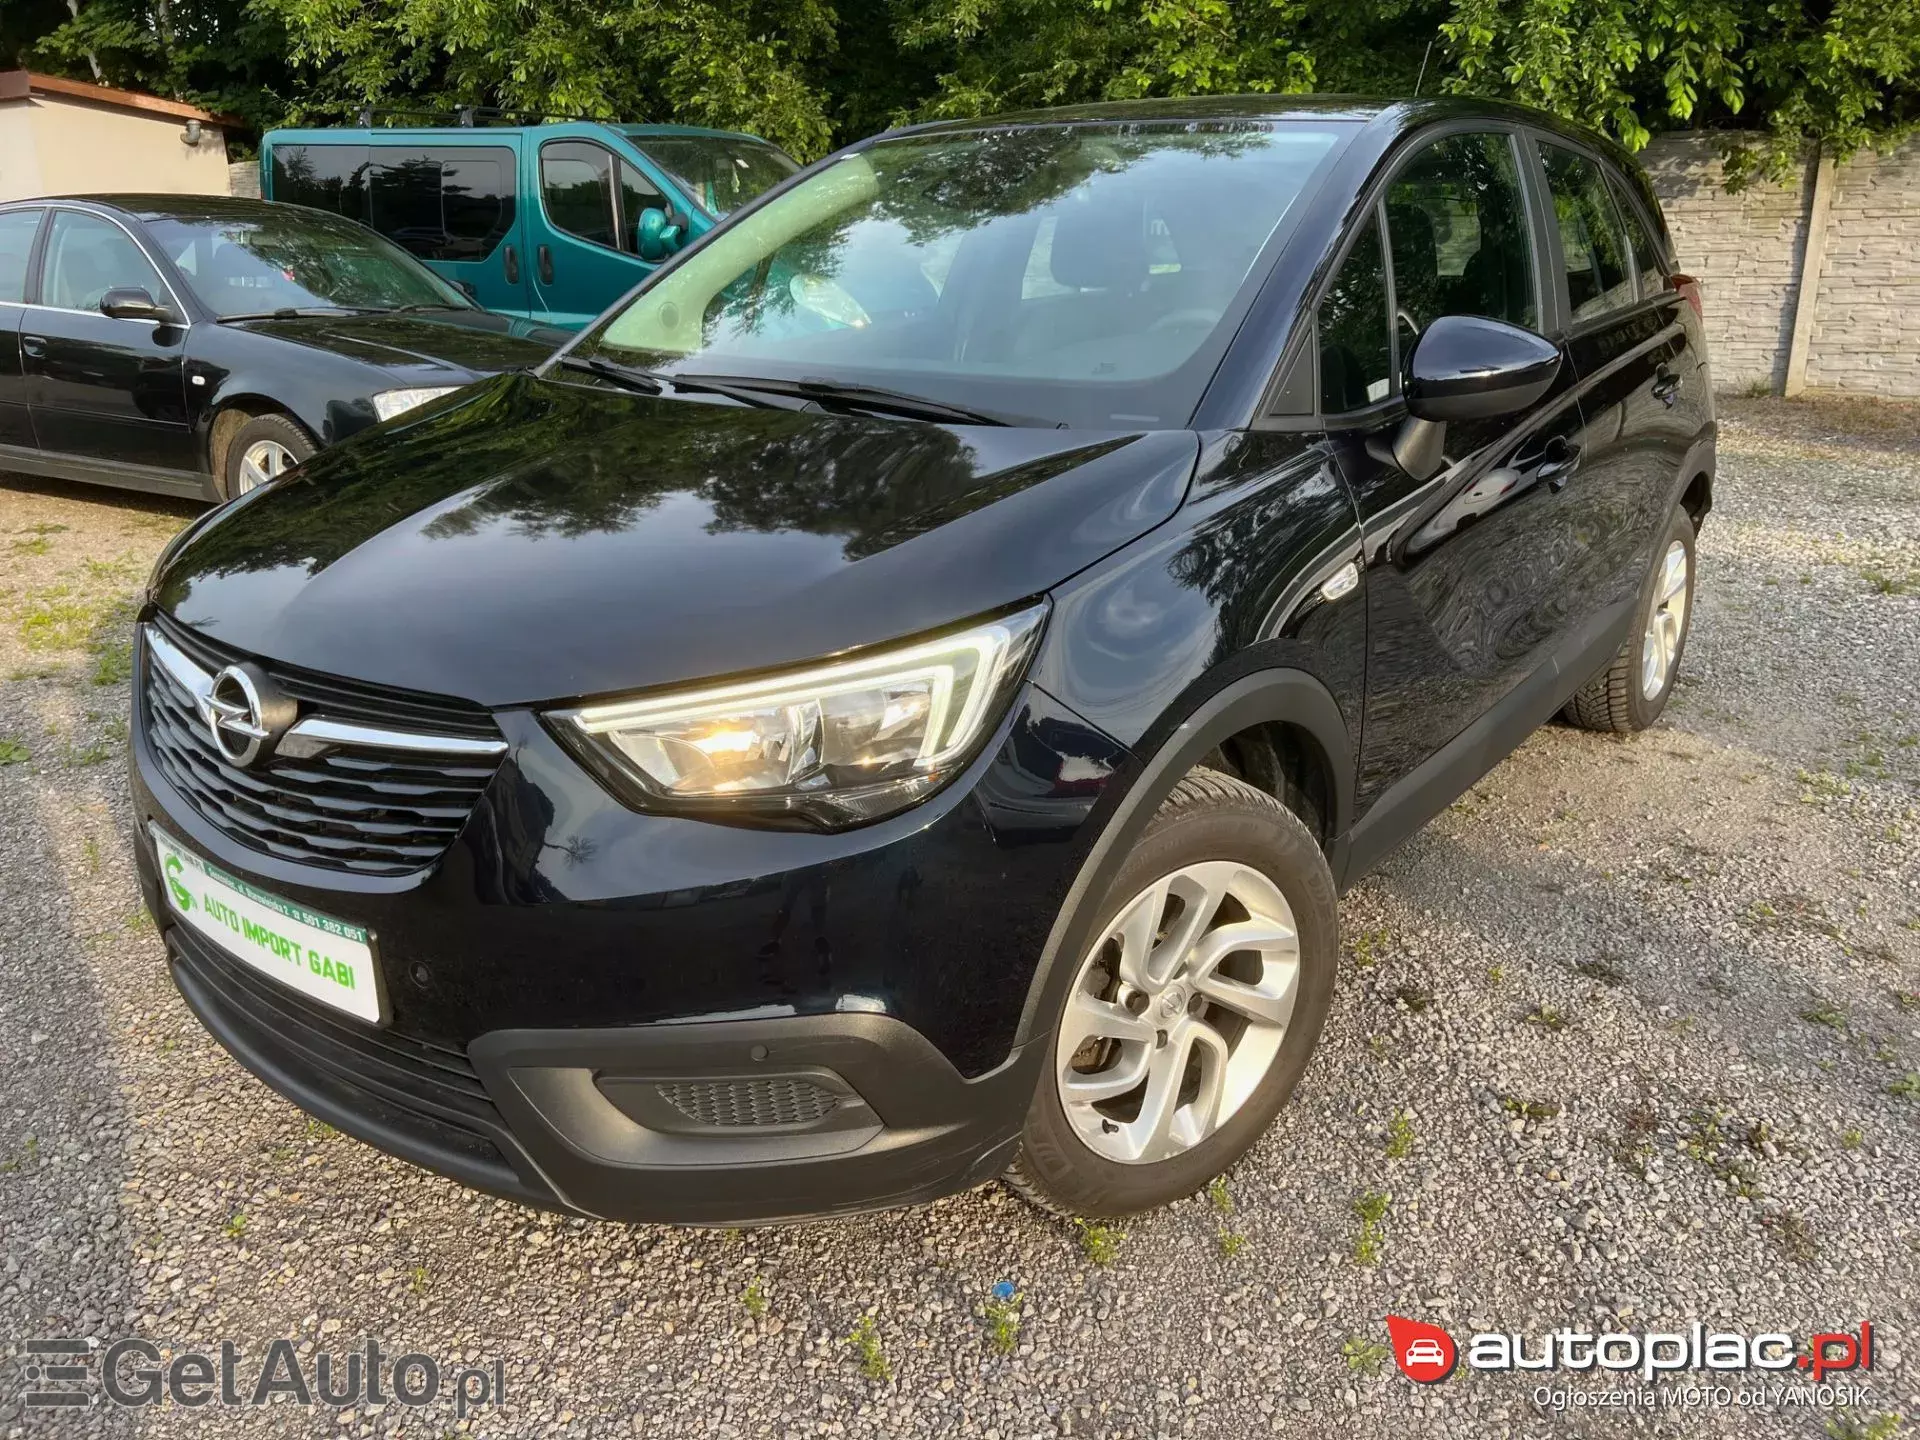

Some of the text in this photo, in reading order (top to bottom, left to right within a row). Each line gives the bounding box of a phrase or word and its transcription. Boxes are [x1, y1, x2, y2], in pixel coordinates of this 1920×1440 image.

[203, 892, 239, 934] AUTO
[242, 915, 302, 967] IMPORT
[308, 949, 356, 990] GABI
[322, 919, 343, 936] 382
[343, 926, 363, 942] 051
